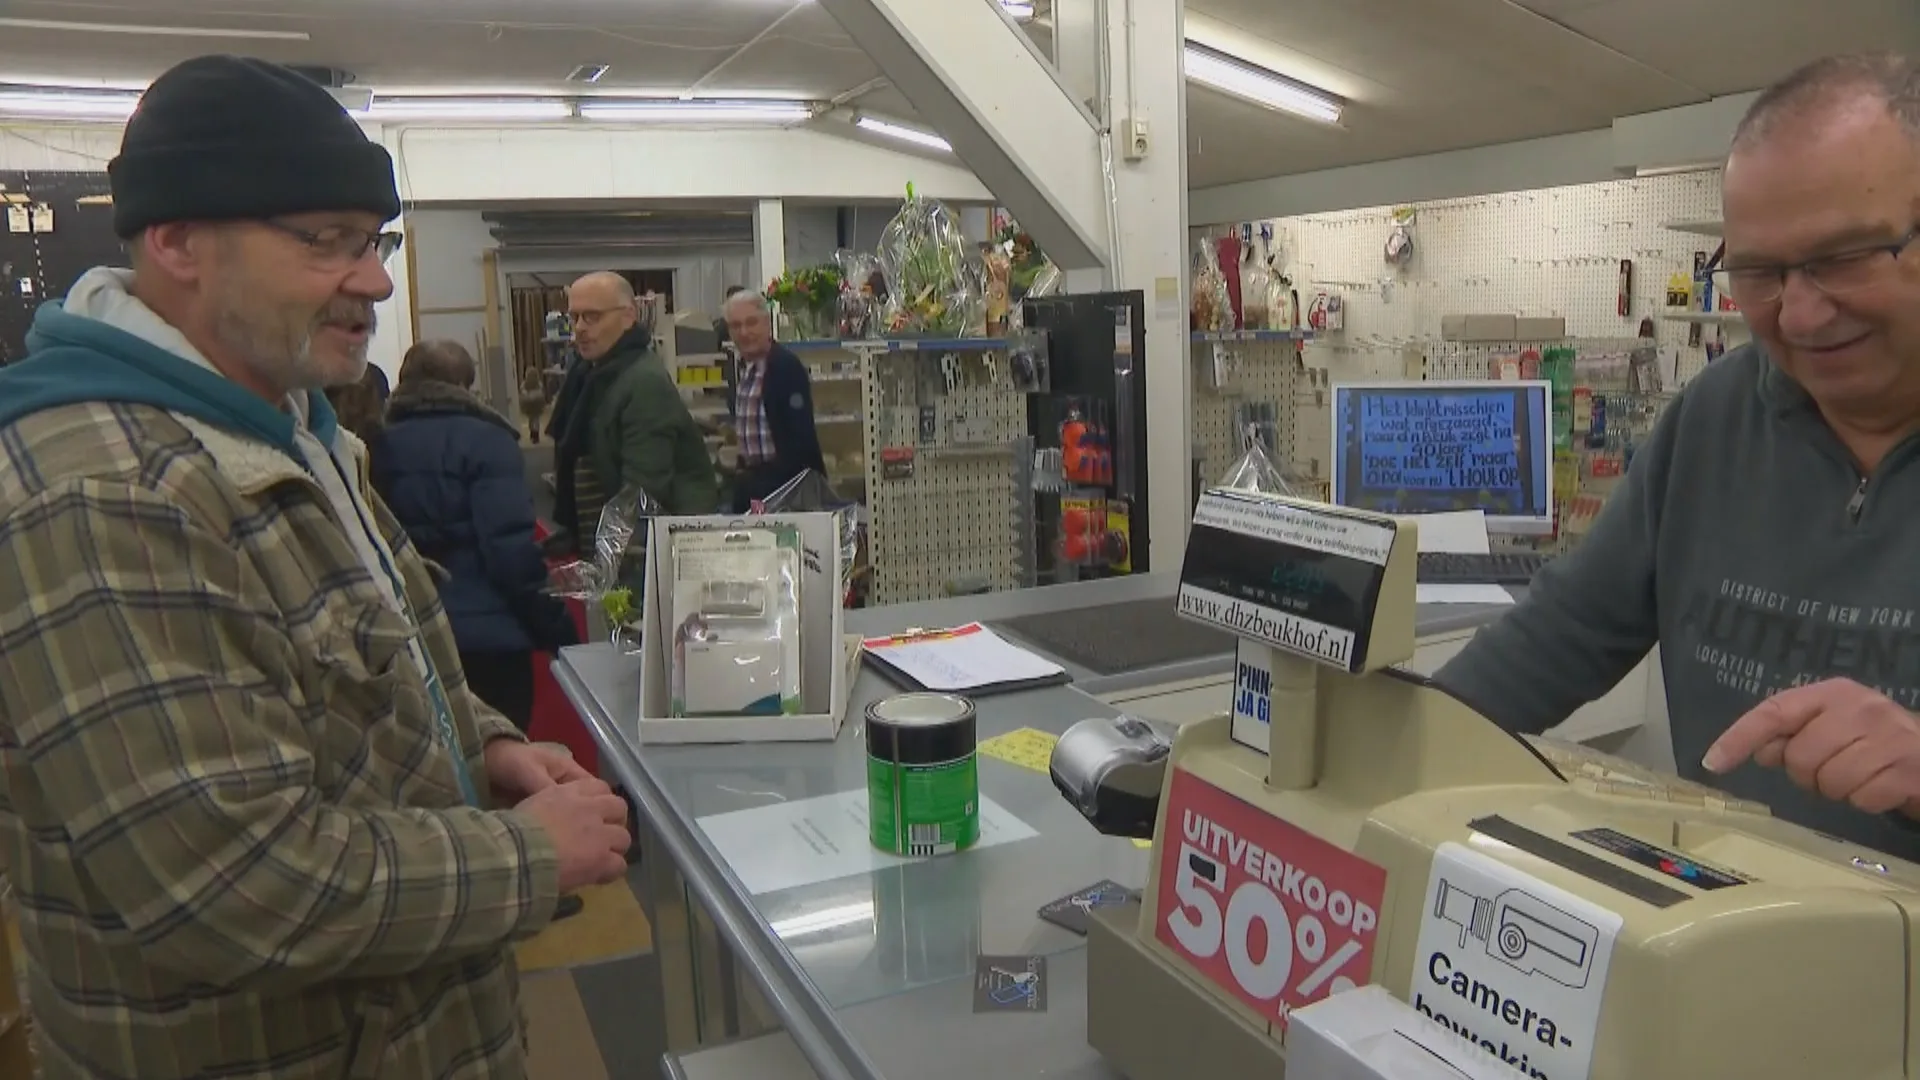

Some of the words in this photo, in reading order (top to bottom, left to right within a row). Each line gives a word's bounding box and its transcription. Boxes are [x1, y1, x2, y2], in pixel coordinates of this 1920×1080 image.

[1182, 593, 1349, 661] www.dhzbeukhof.nl
[1678, 588, 1920, 682] AUTHEN
[1720, 578, 1790, 611] DISTRICT
[1797, 599, 1822, 618] OF
[1827, 603, 1862, 625] NEW
[1868, 606, 1915, 629] YORK
[1238, 661, 1273, 696] PINN
[1695, 643, 1765, 680] LOCATION
[1183, 807, 1377, 937] UITVERKOOP
[1166, 840, 1364, 1002] 50%
[1428, 951, 1573, 1049] Camera-
